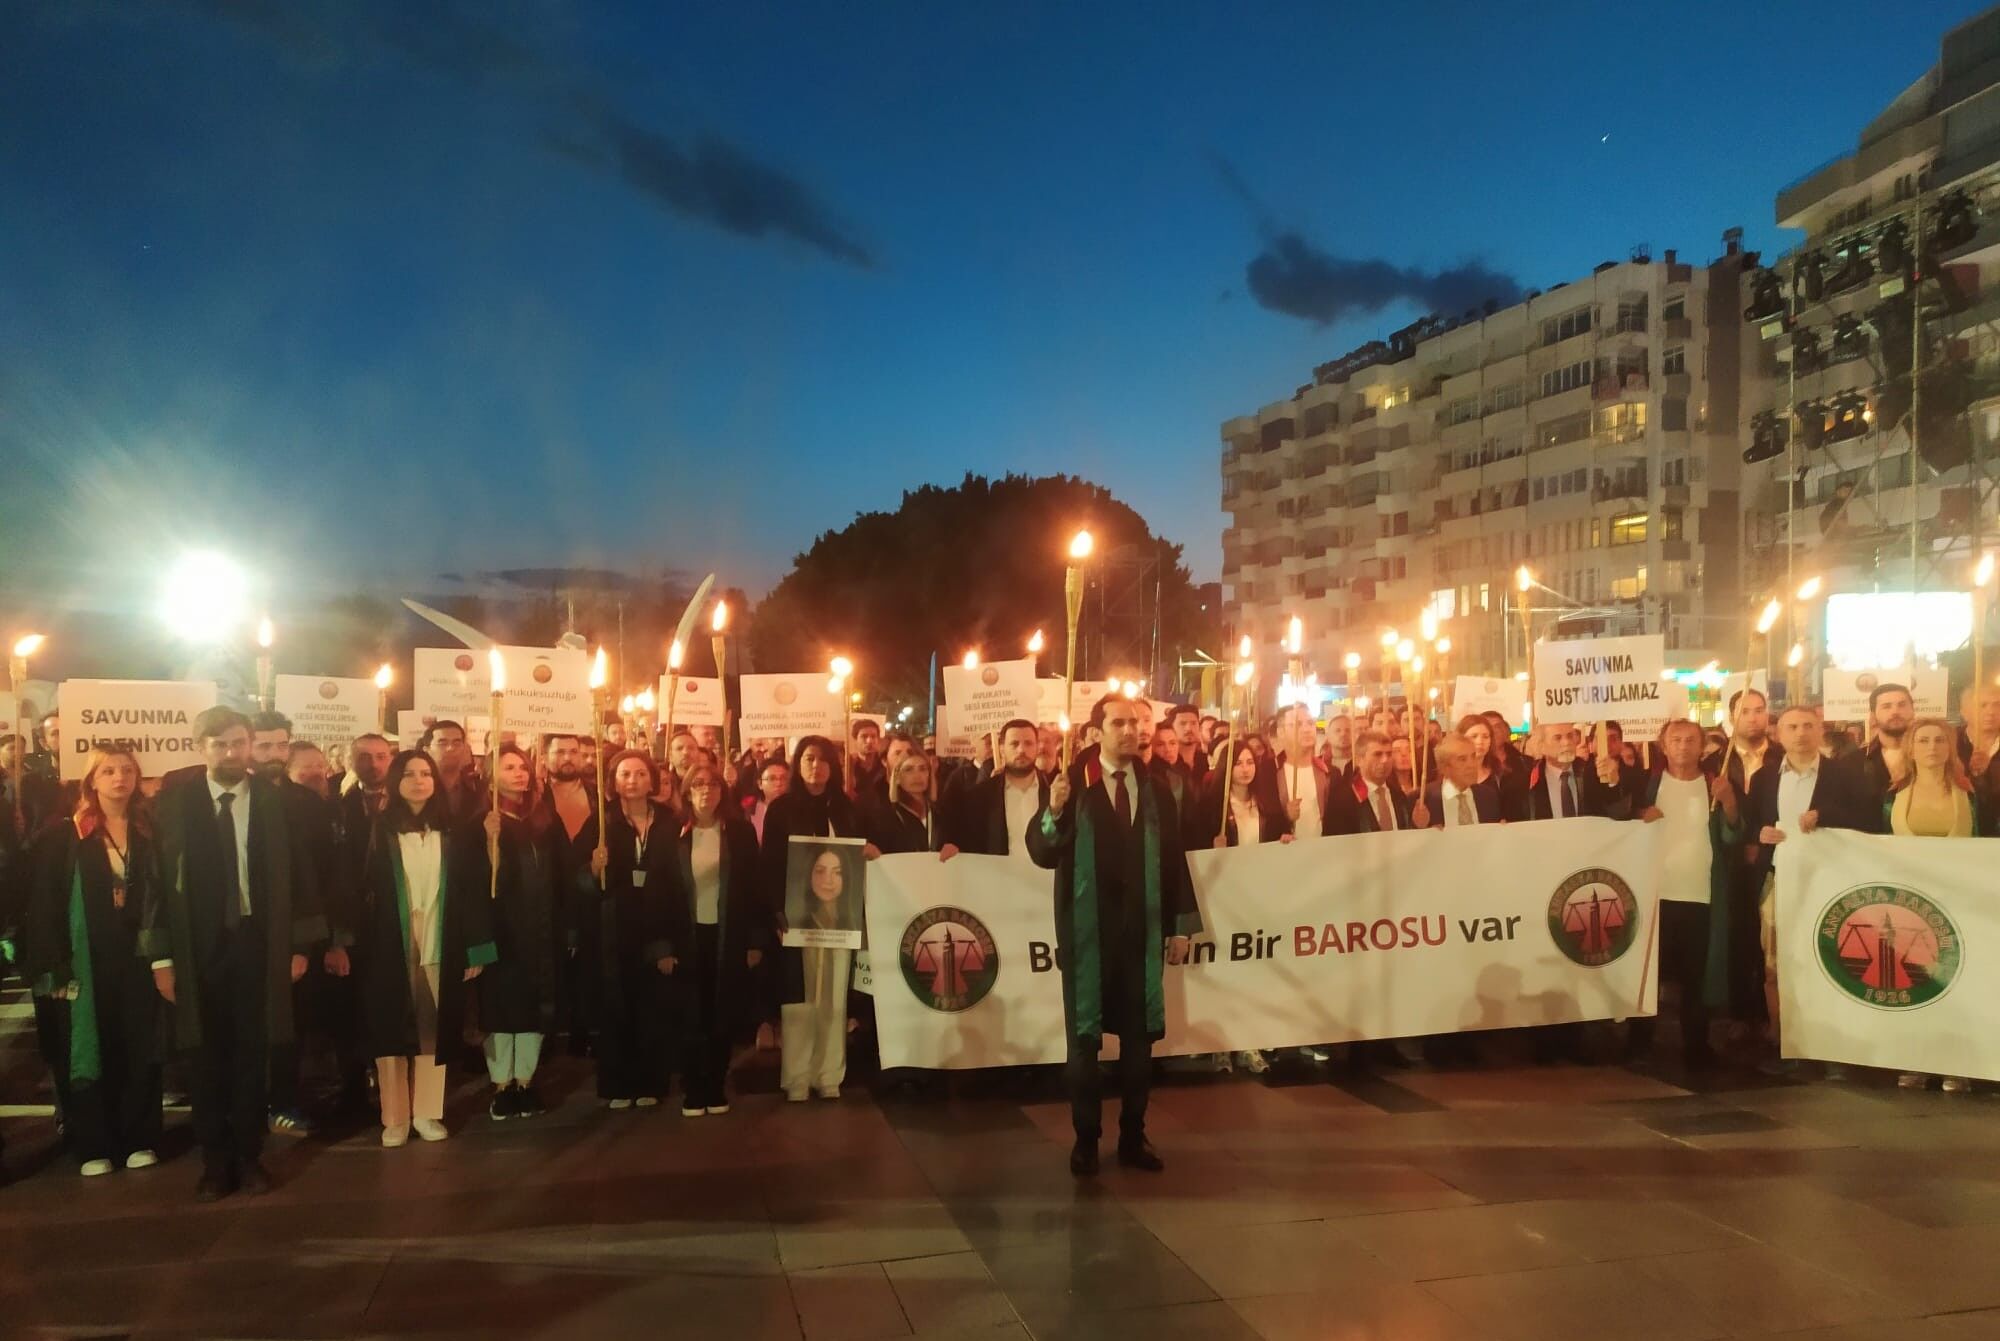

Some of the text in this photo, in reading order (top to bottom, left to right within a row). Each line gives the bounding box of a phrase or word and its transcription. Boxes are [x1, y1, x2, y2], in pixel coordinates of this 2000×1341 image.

[1565, 654, 1634, 676] SAVUNMA
[1545, 682, 1659, 706] SUSTURULAMAZ
[80, 708, 188, 725] SAVUNMA
[1230, 929, 1282, 962] Bir
[1293, 914, 1447, 957] BAROSU
[1458, 915, 1522, 943] var
